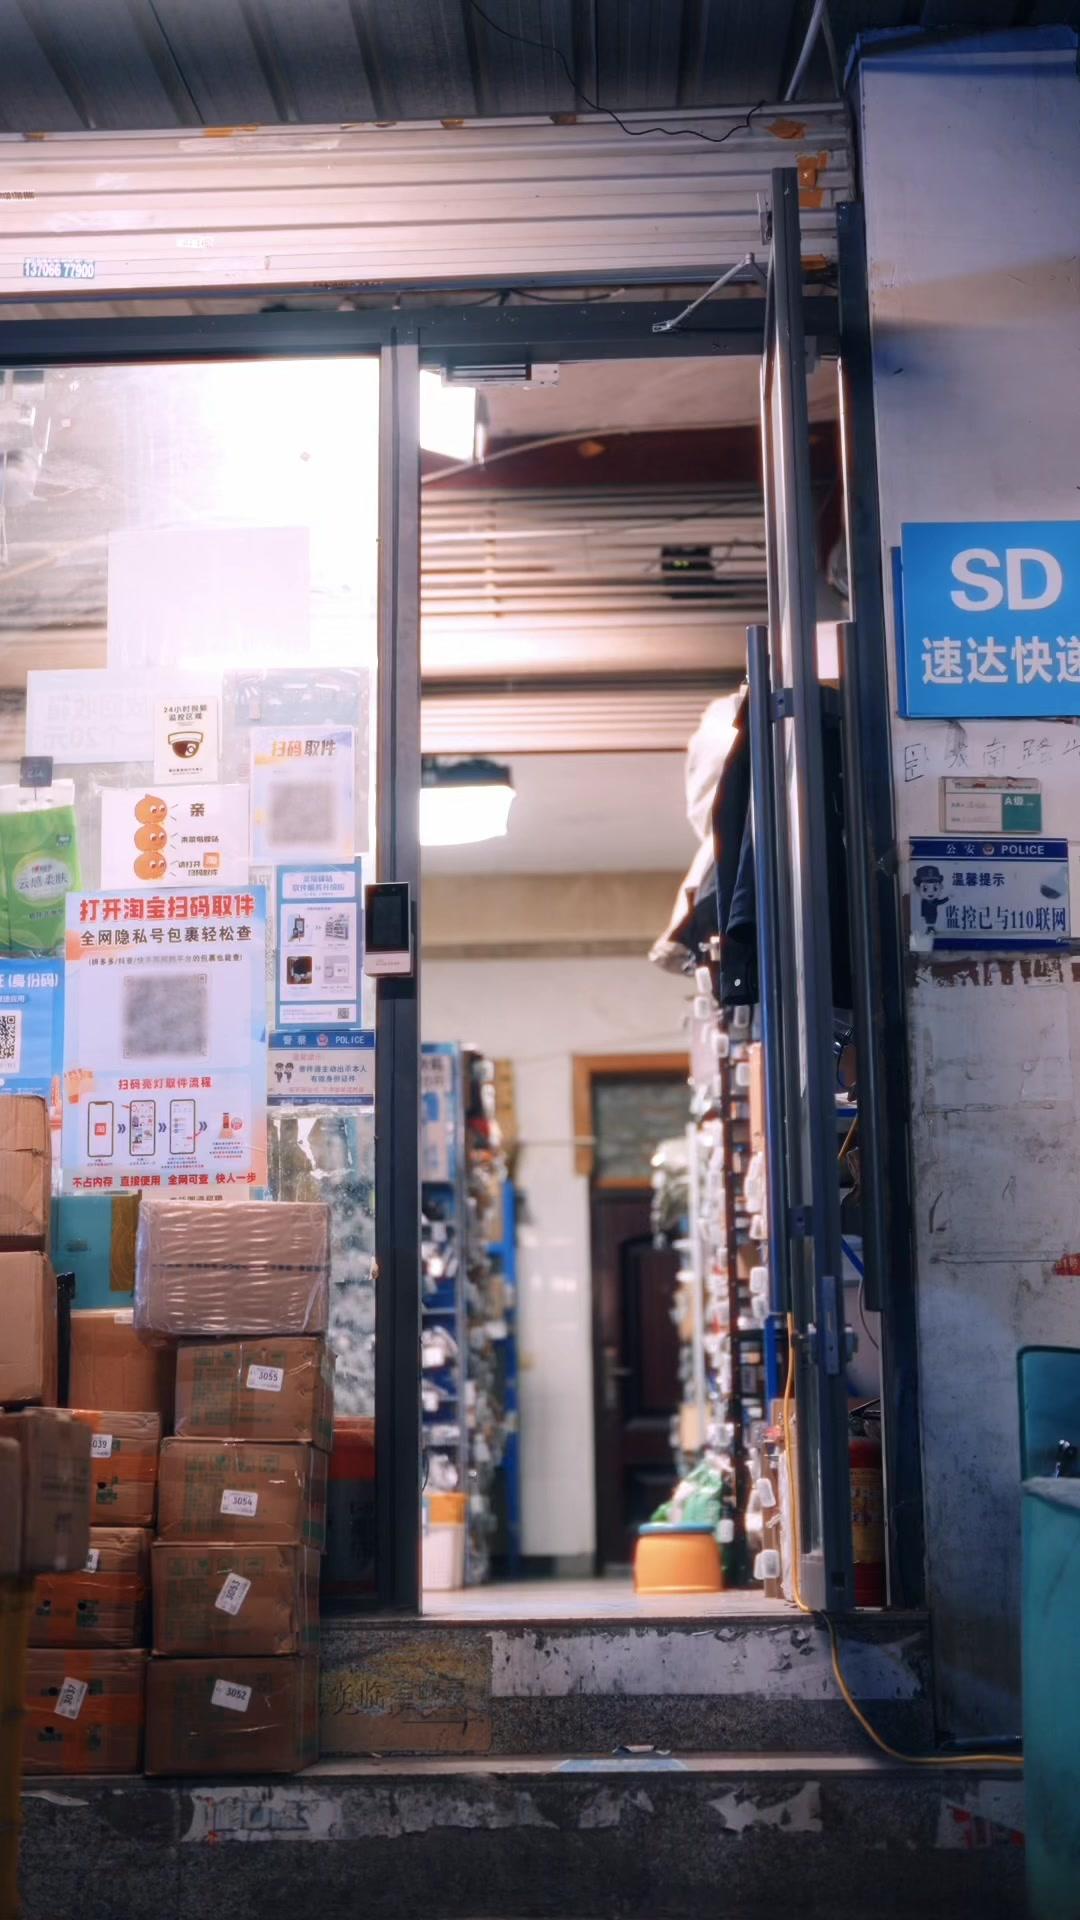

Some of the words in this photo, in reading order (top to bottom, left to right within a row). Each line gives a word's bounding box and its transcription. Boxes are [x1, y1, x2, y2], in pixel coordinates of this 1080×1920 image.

[63, 262, 95, 278] 77900
[950, 548, 1063, 612] SD
[271, 738, 337, 757] 扫码取件
[190, 803, 205, 817] 亲
[946, 844, 975, 855] 公安
[1001, 845, 1045, 855] POLICE
[952, 872, 1005, 887] 温馨提示
[79, 894, 257, 923] 打开淘宝扫码取件
[946, 905, 1066, 931] 监控已与110联网
[80, 925, 252, 947] 全网隐私号包裹轻松查
[335, 1035, 365, 1044] POLICE
[118, 1076, 213, 1091] 扫码亮灯取件流程
[72, 1176, 114, 1188] 不占内存
[120, 1175, 161, 1187] 直接使用
[168, 1174, 209, 1185] 全网可查
[215, 1171, 257, 1184] 快人一步
[89, 1439, 107, 1449] 039
[226, 1687, 247, 1700] 3052
